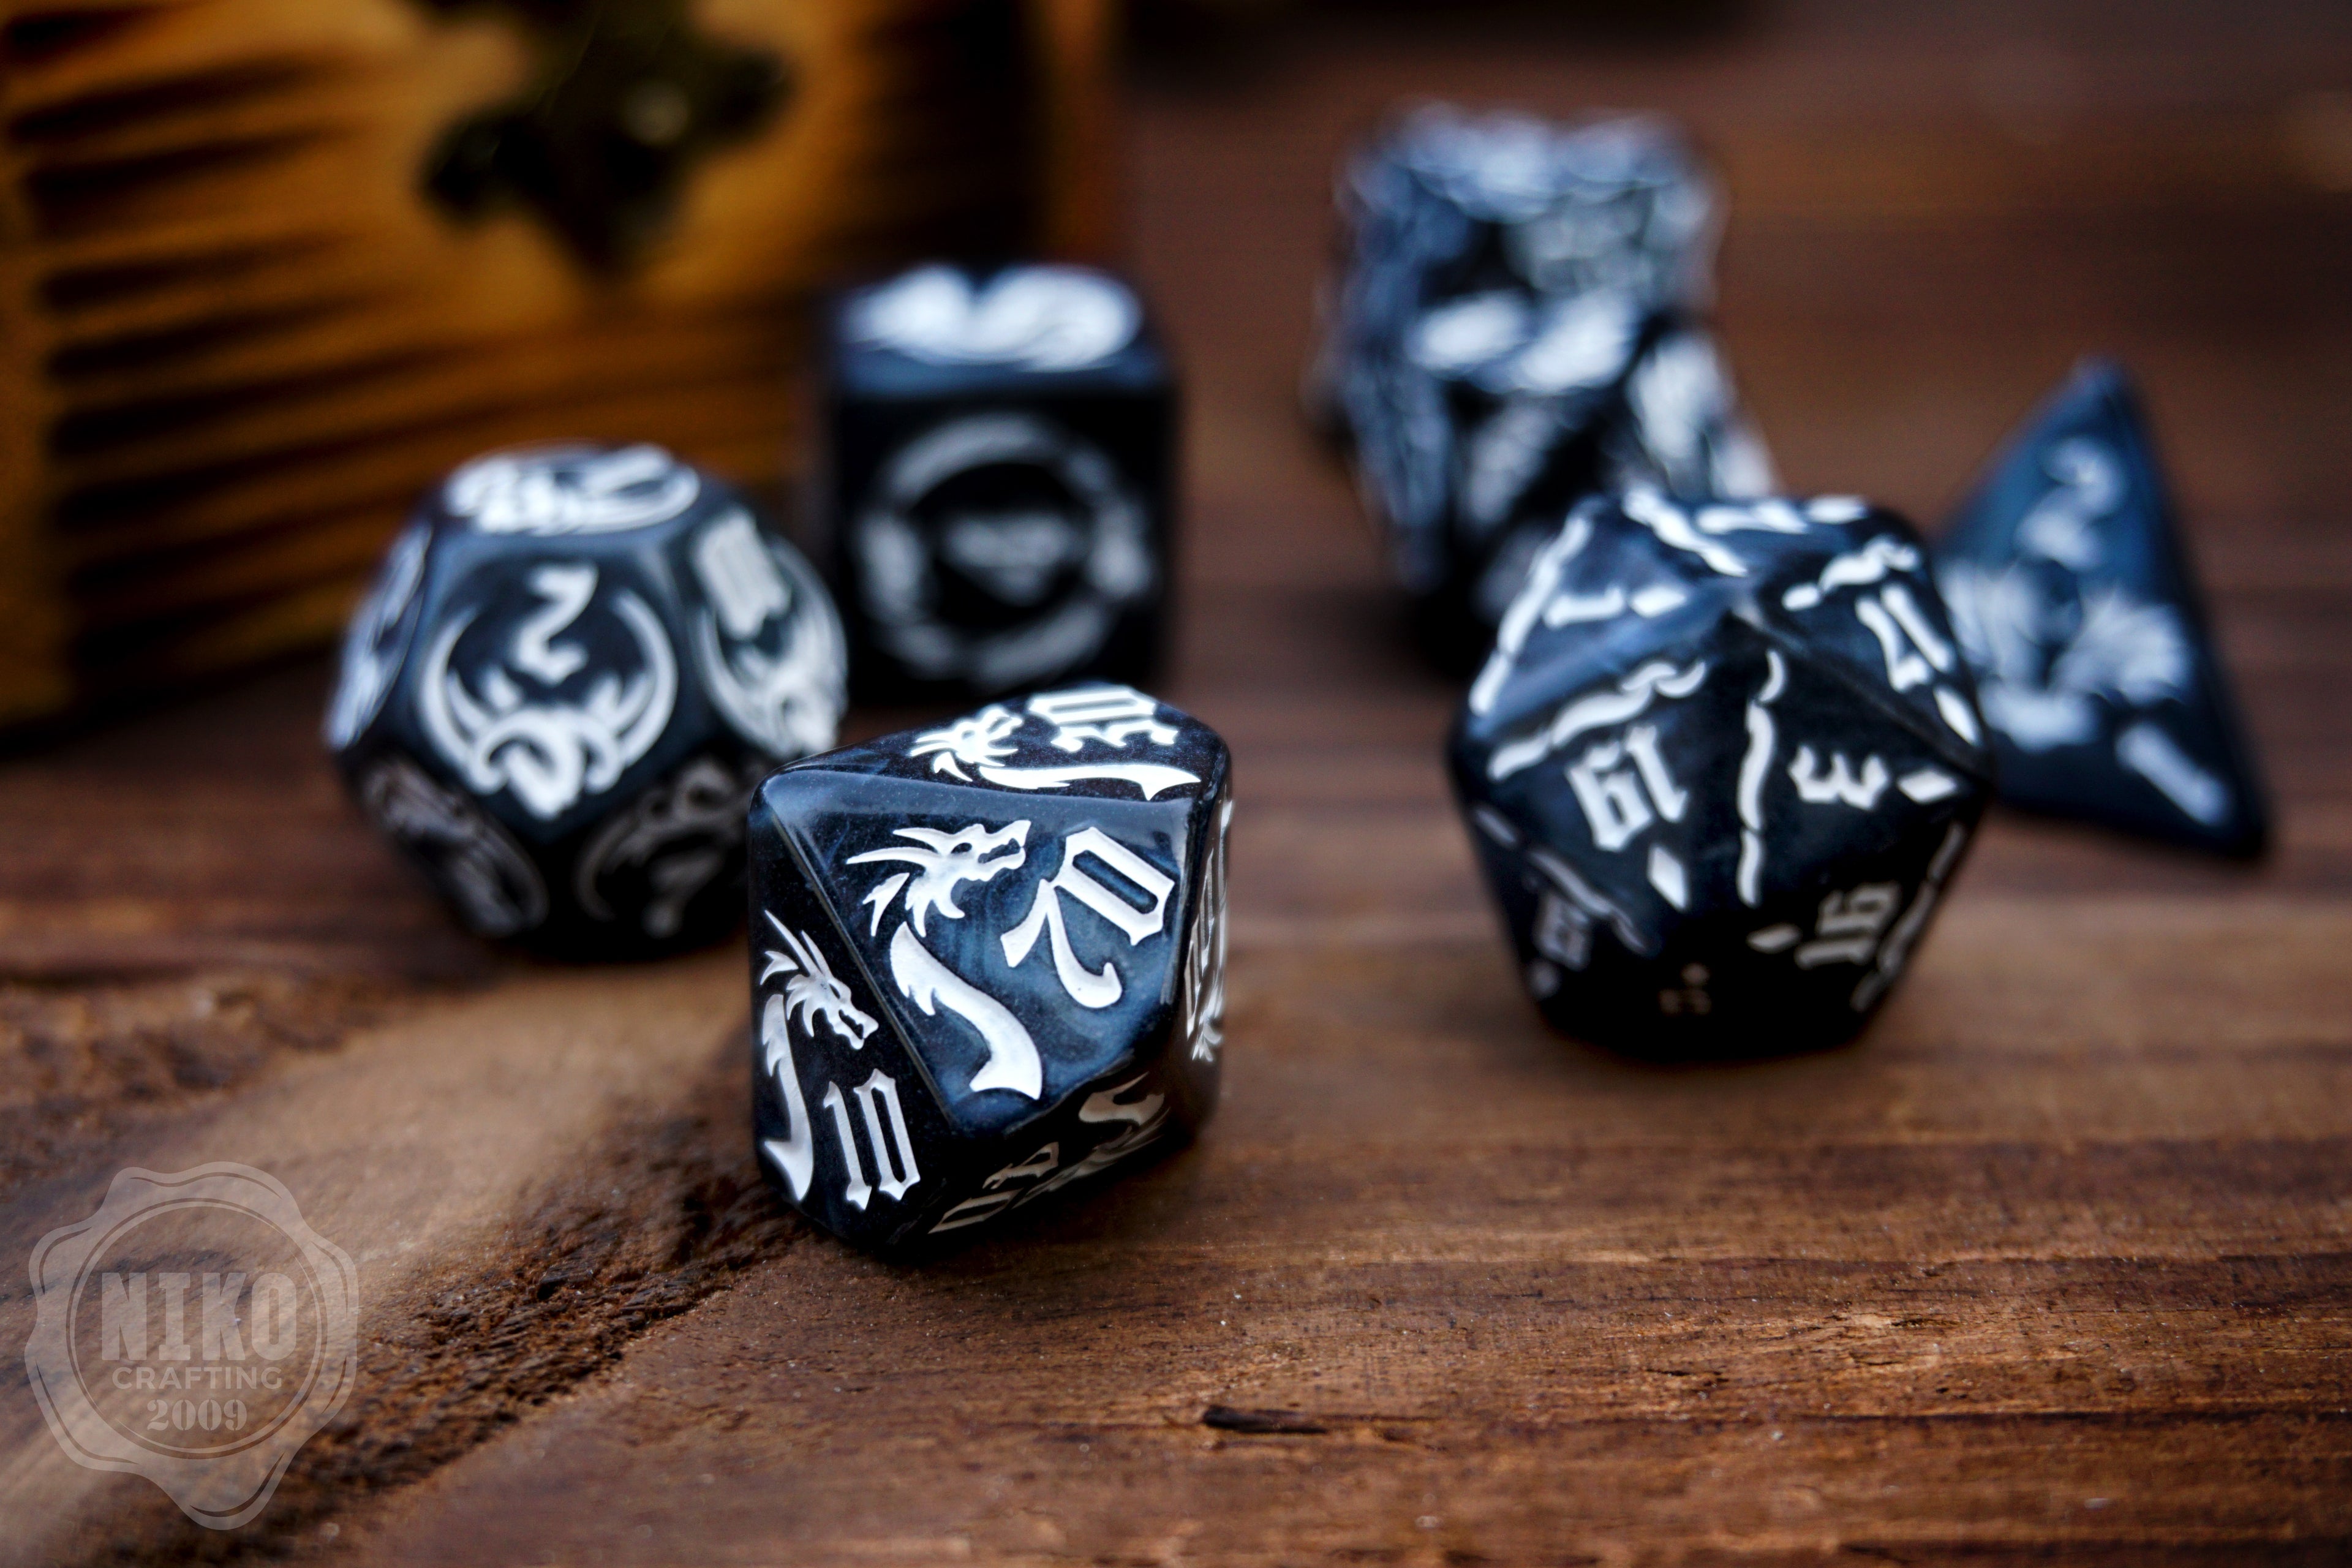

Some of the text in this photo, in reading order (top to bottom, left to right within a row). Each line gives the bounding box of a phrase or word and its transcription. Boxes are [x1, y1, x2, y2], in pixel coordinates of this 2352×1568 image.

[1564, 725, 1689, 852] 19
[1789, 746, 1890, 810] 3
[1000, 827, 1175, 1009] 70
[823, 1068, 921, 1210] 10
